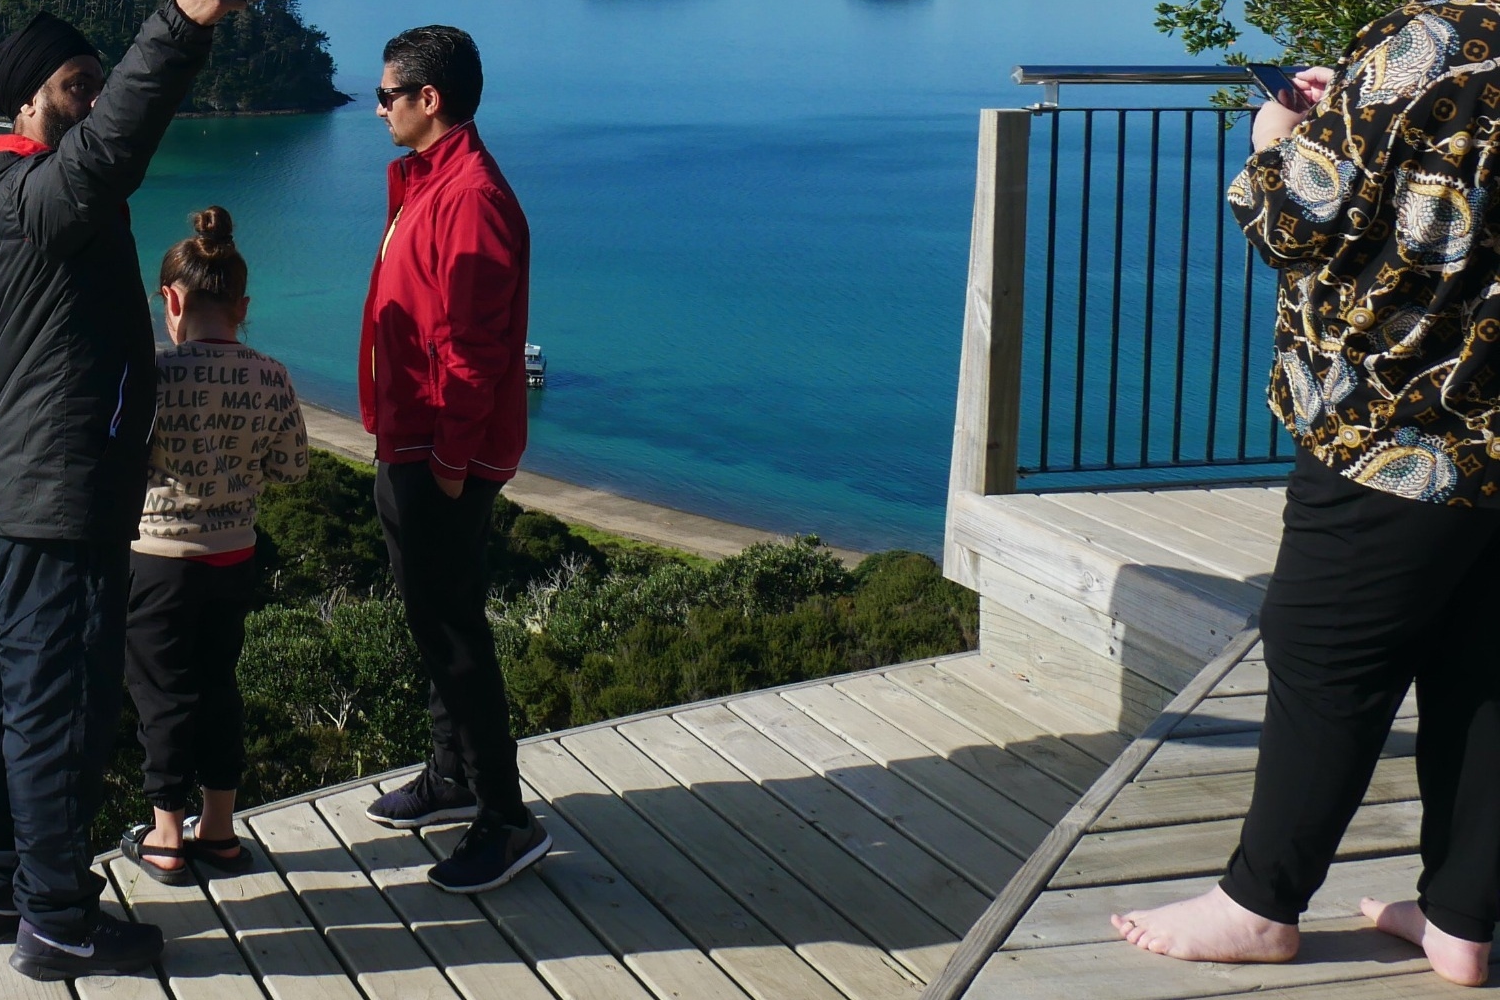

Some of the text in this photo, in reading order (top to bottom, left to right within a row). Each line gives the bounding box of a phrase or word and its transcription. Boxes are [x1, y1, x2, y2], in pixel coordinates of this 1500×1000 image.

[194, 365, 250, 385] ELLIE
[156, 389, 209, 410] ELLIE
[221, 390, 262, 410] MAC
[157, 413, 201, 432] MAC
[204, 413, 247, 431] AND
[192, 434, 239, 454] ELLIE
[164, 456, 208, 478] MAC
